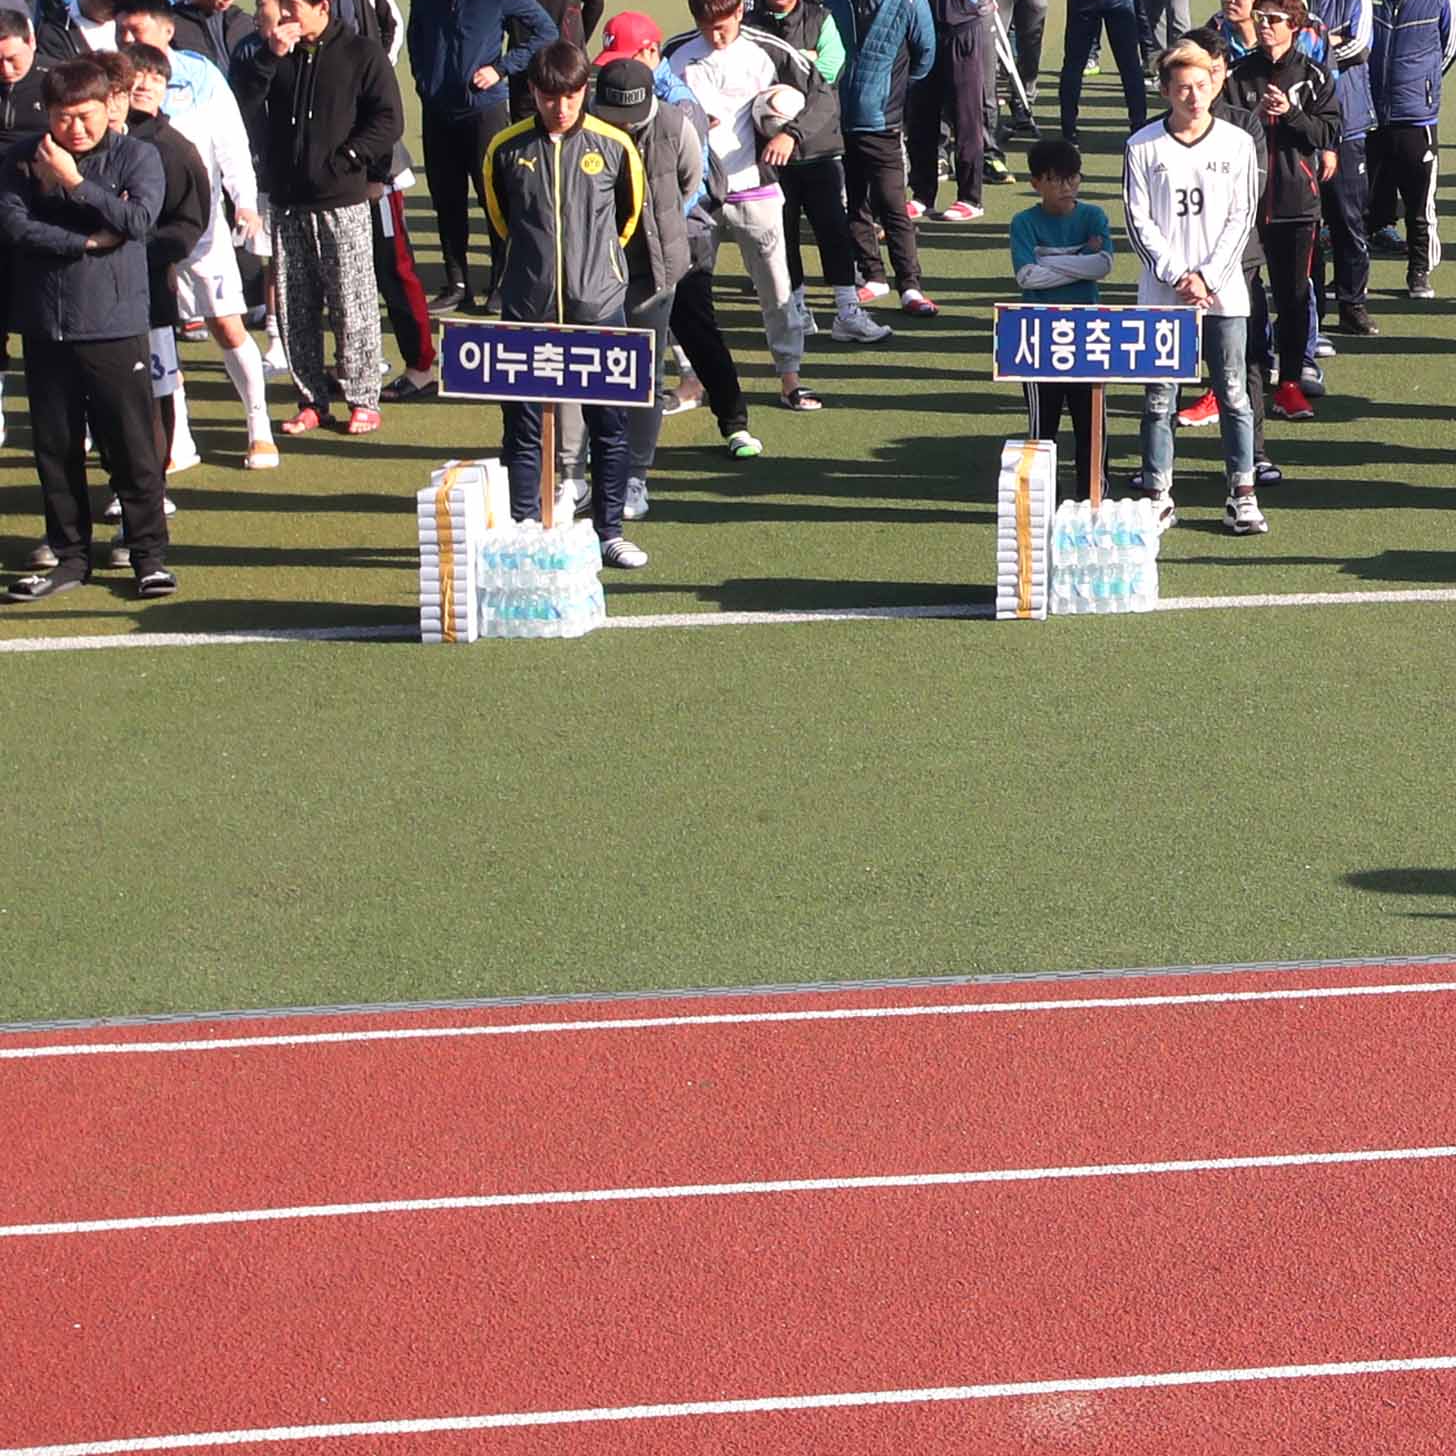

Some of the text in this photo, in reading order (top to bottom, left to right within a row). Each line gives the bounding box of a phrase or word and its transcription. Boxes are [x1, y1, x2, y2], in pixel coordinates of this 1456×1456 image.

[1175, 187, 1205, 217] 39
[213, 275, 225, 300] 7
[1014, 317, 1181, 371] 서흥축구회
[458, 341, 638, 390] 이누축구회
